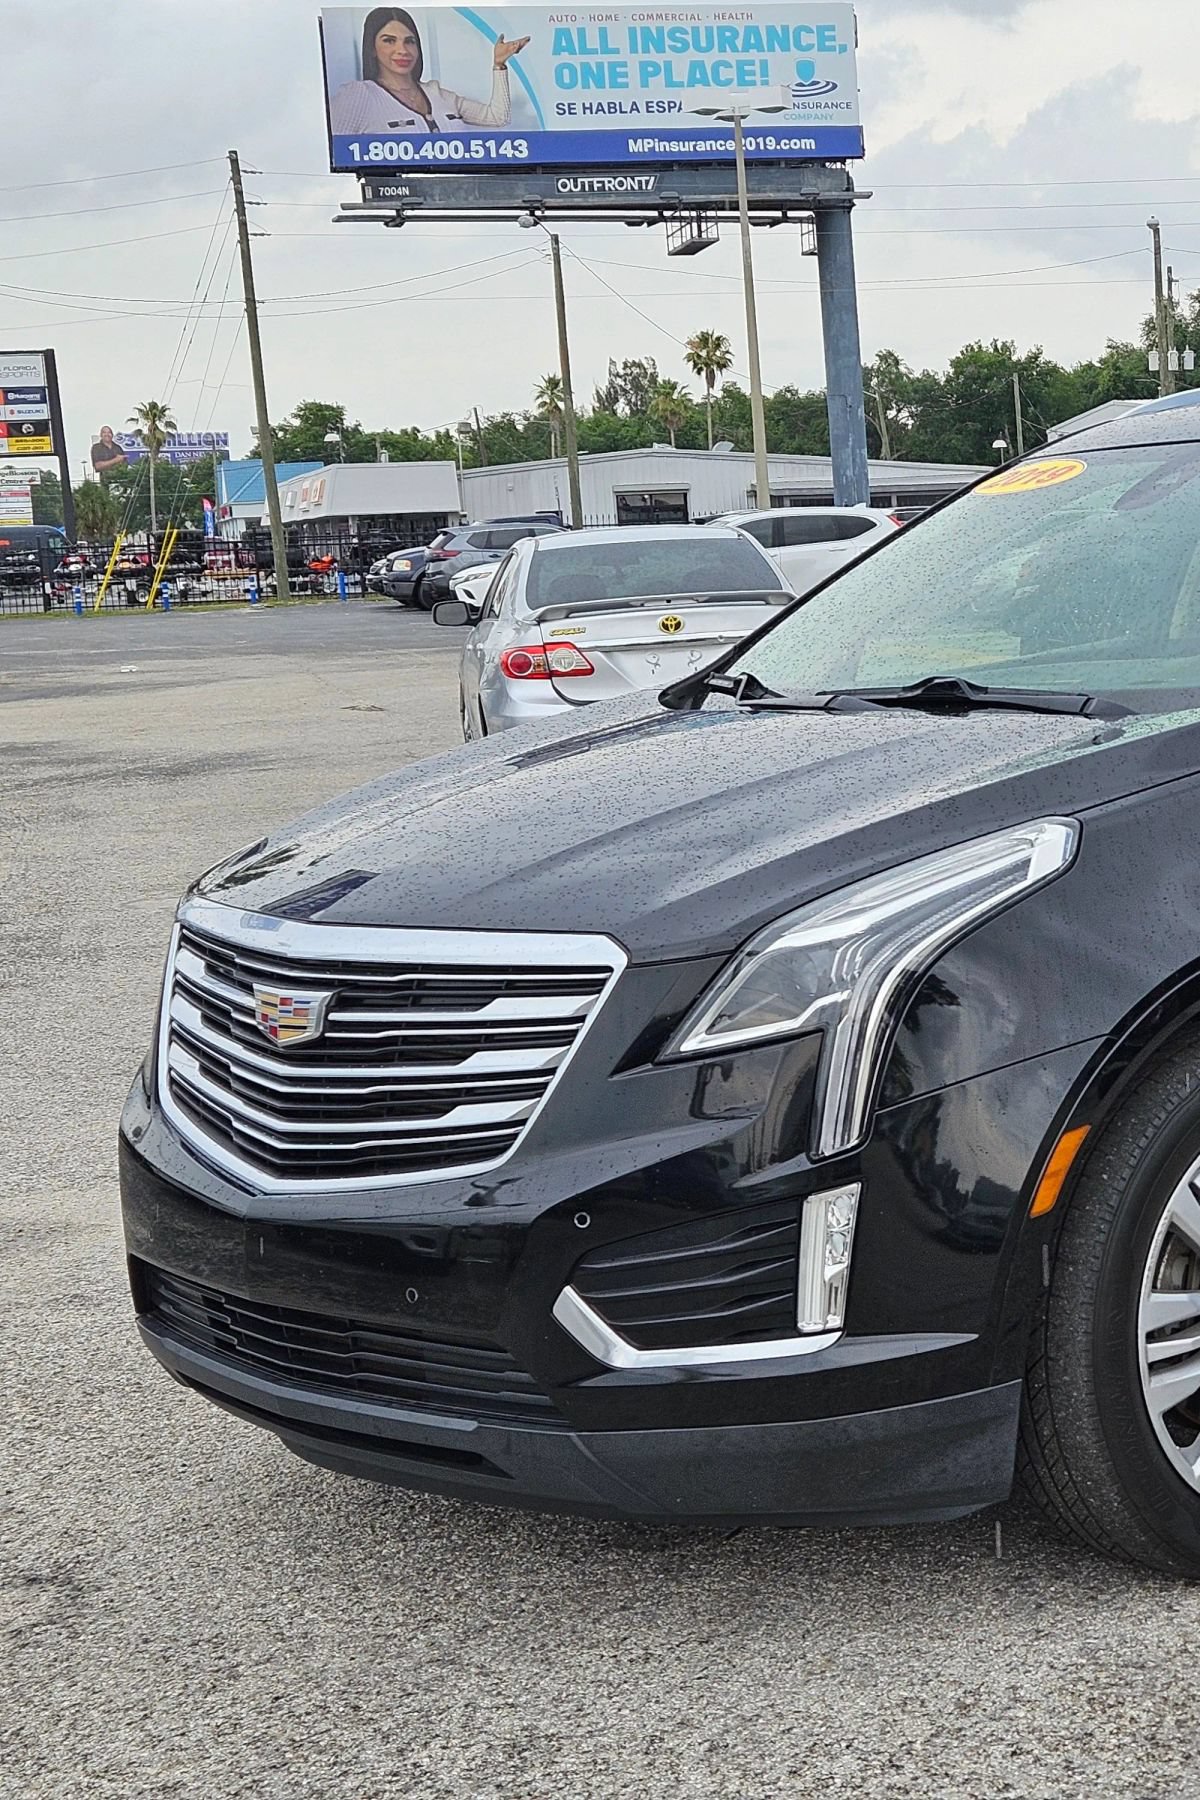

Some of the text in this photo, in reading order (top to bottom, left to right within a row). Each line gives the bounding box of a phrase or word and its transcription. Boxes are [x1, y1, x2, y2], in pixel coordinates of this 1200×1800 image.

[549, 12, 753, 23] AUTO HOME COMMERCIAL HEALTH
[552, 24, 848, 55] ALL INSURANCE,
[554, 59, 770, 89] ONE PLACE!
[556, 102, 577, 115] SE
[582, 101, 641, 115] HABLA
[792, 101, 853, 110] NSURANCE
[783, 113, 834, 121] COMPANY
[348, 138, 529, 161] 1.800.400.5143
[378, 186, 410, 197] 7004N
